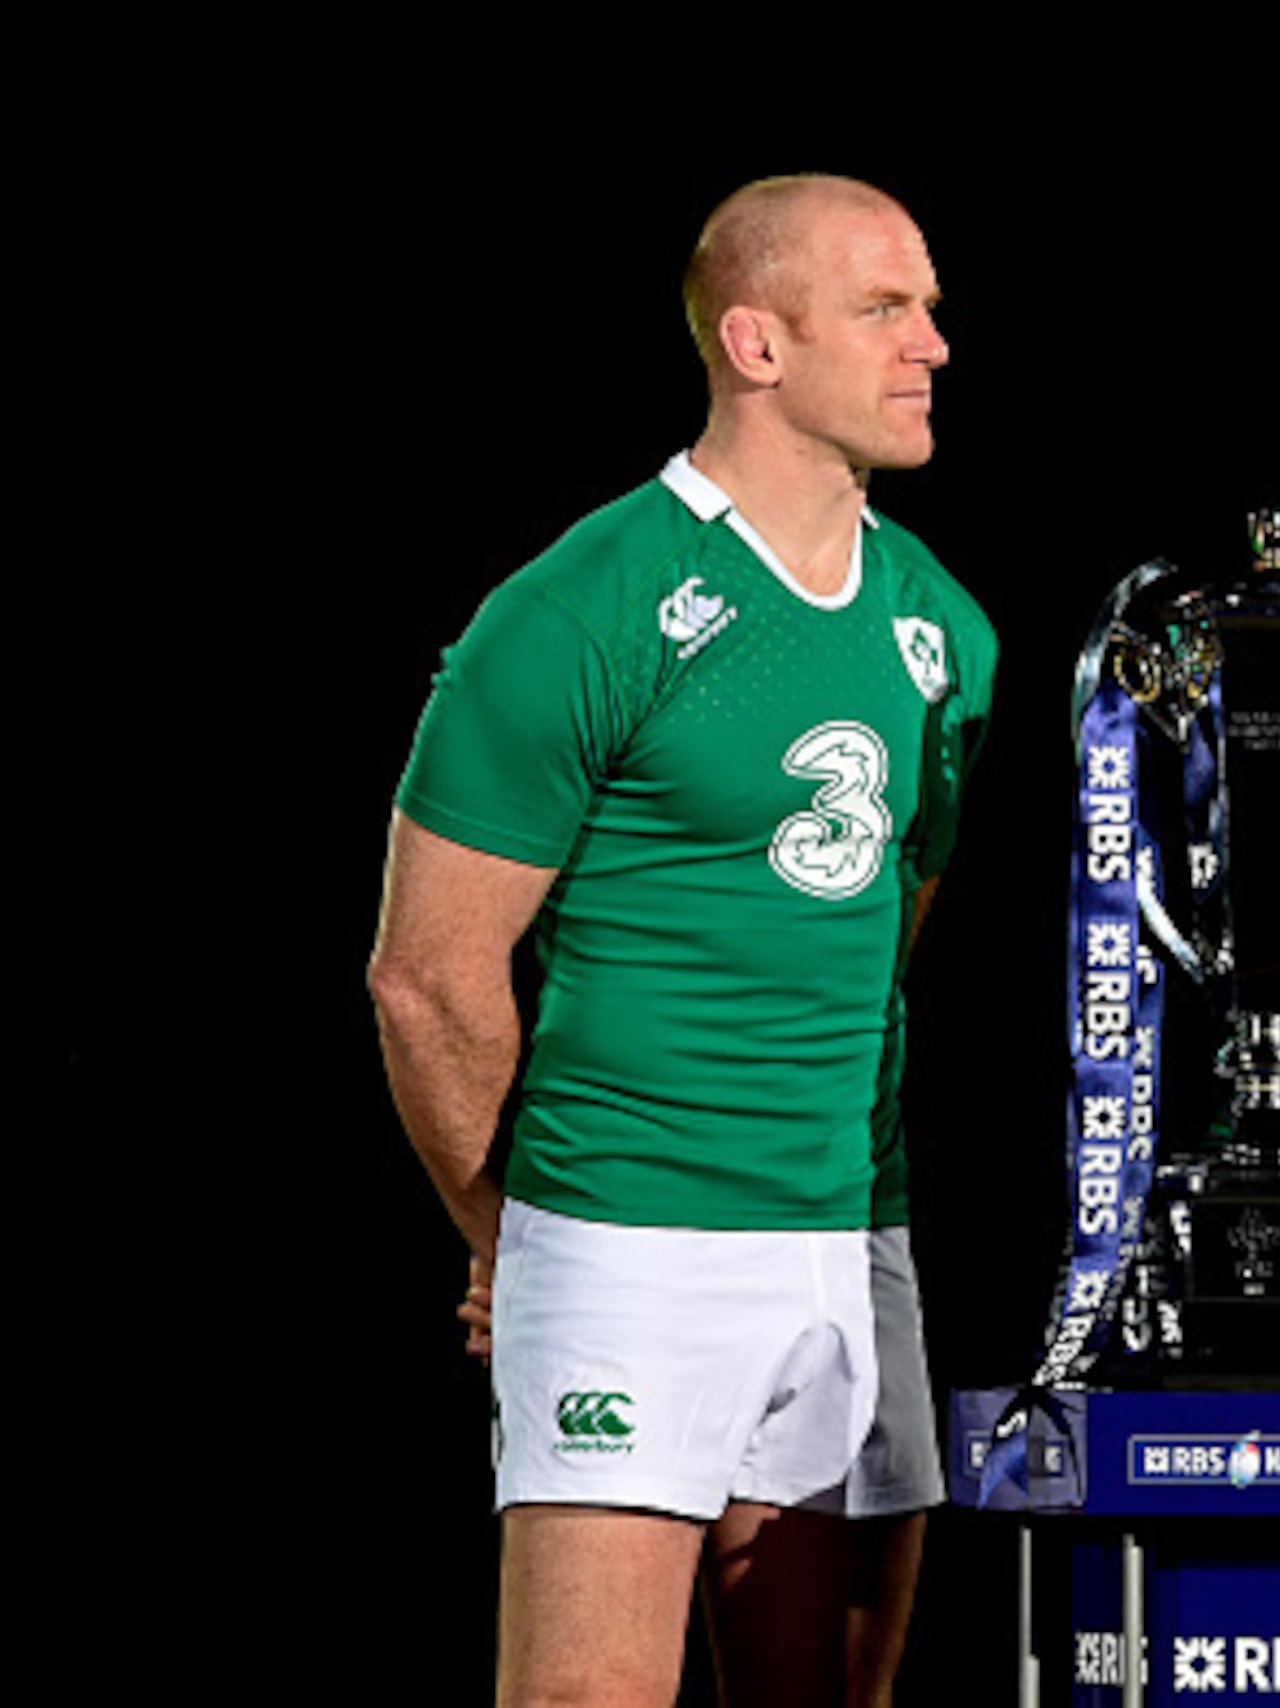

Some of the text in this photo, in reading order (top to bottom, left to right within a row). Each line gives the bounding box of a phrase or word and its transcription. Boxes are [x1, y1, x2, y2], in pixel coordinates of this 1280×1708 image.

[768, 720, 893, 900] 3
[1088, 794, 1131, 883] RBS
[1087, 972, 1130, 1060] RBS
[1079, 1145, 1122, 1235] RBS
[1172, 1447, 1225, 1475] RBS
